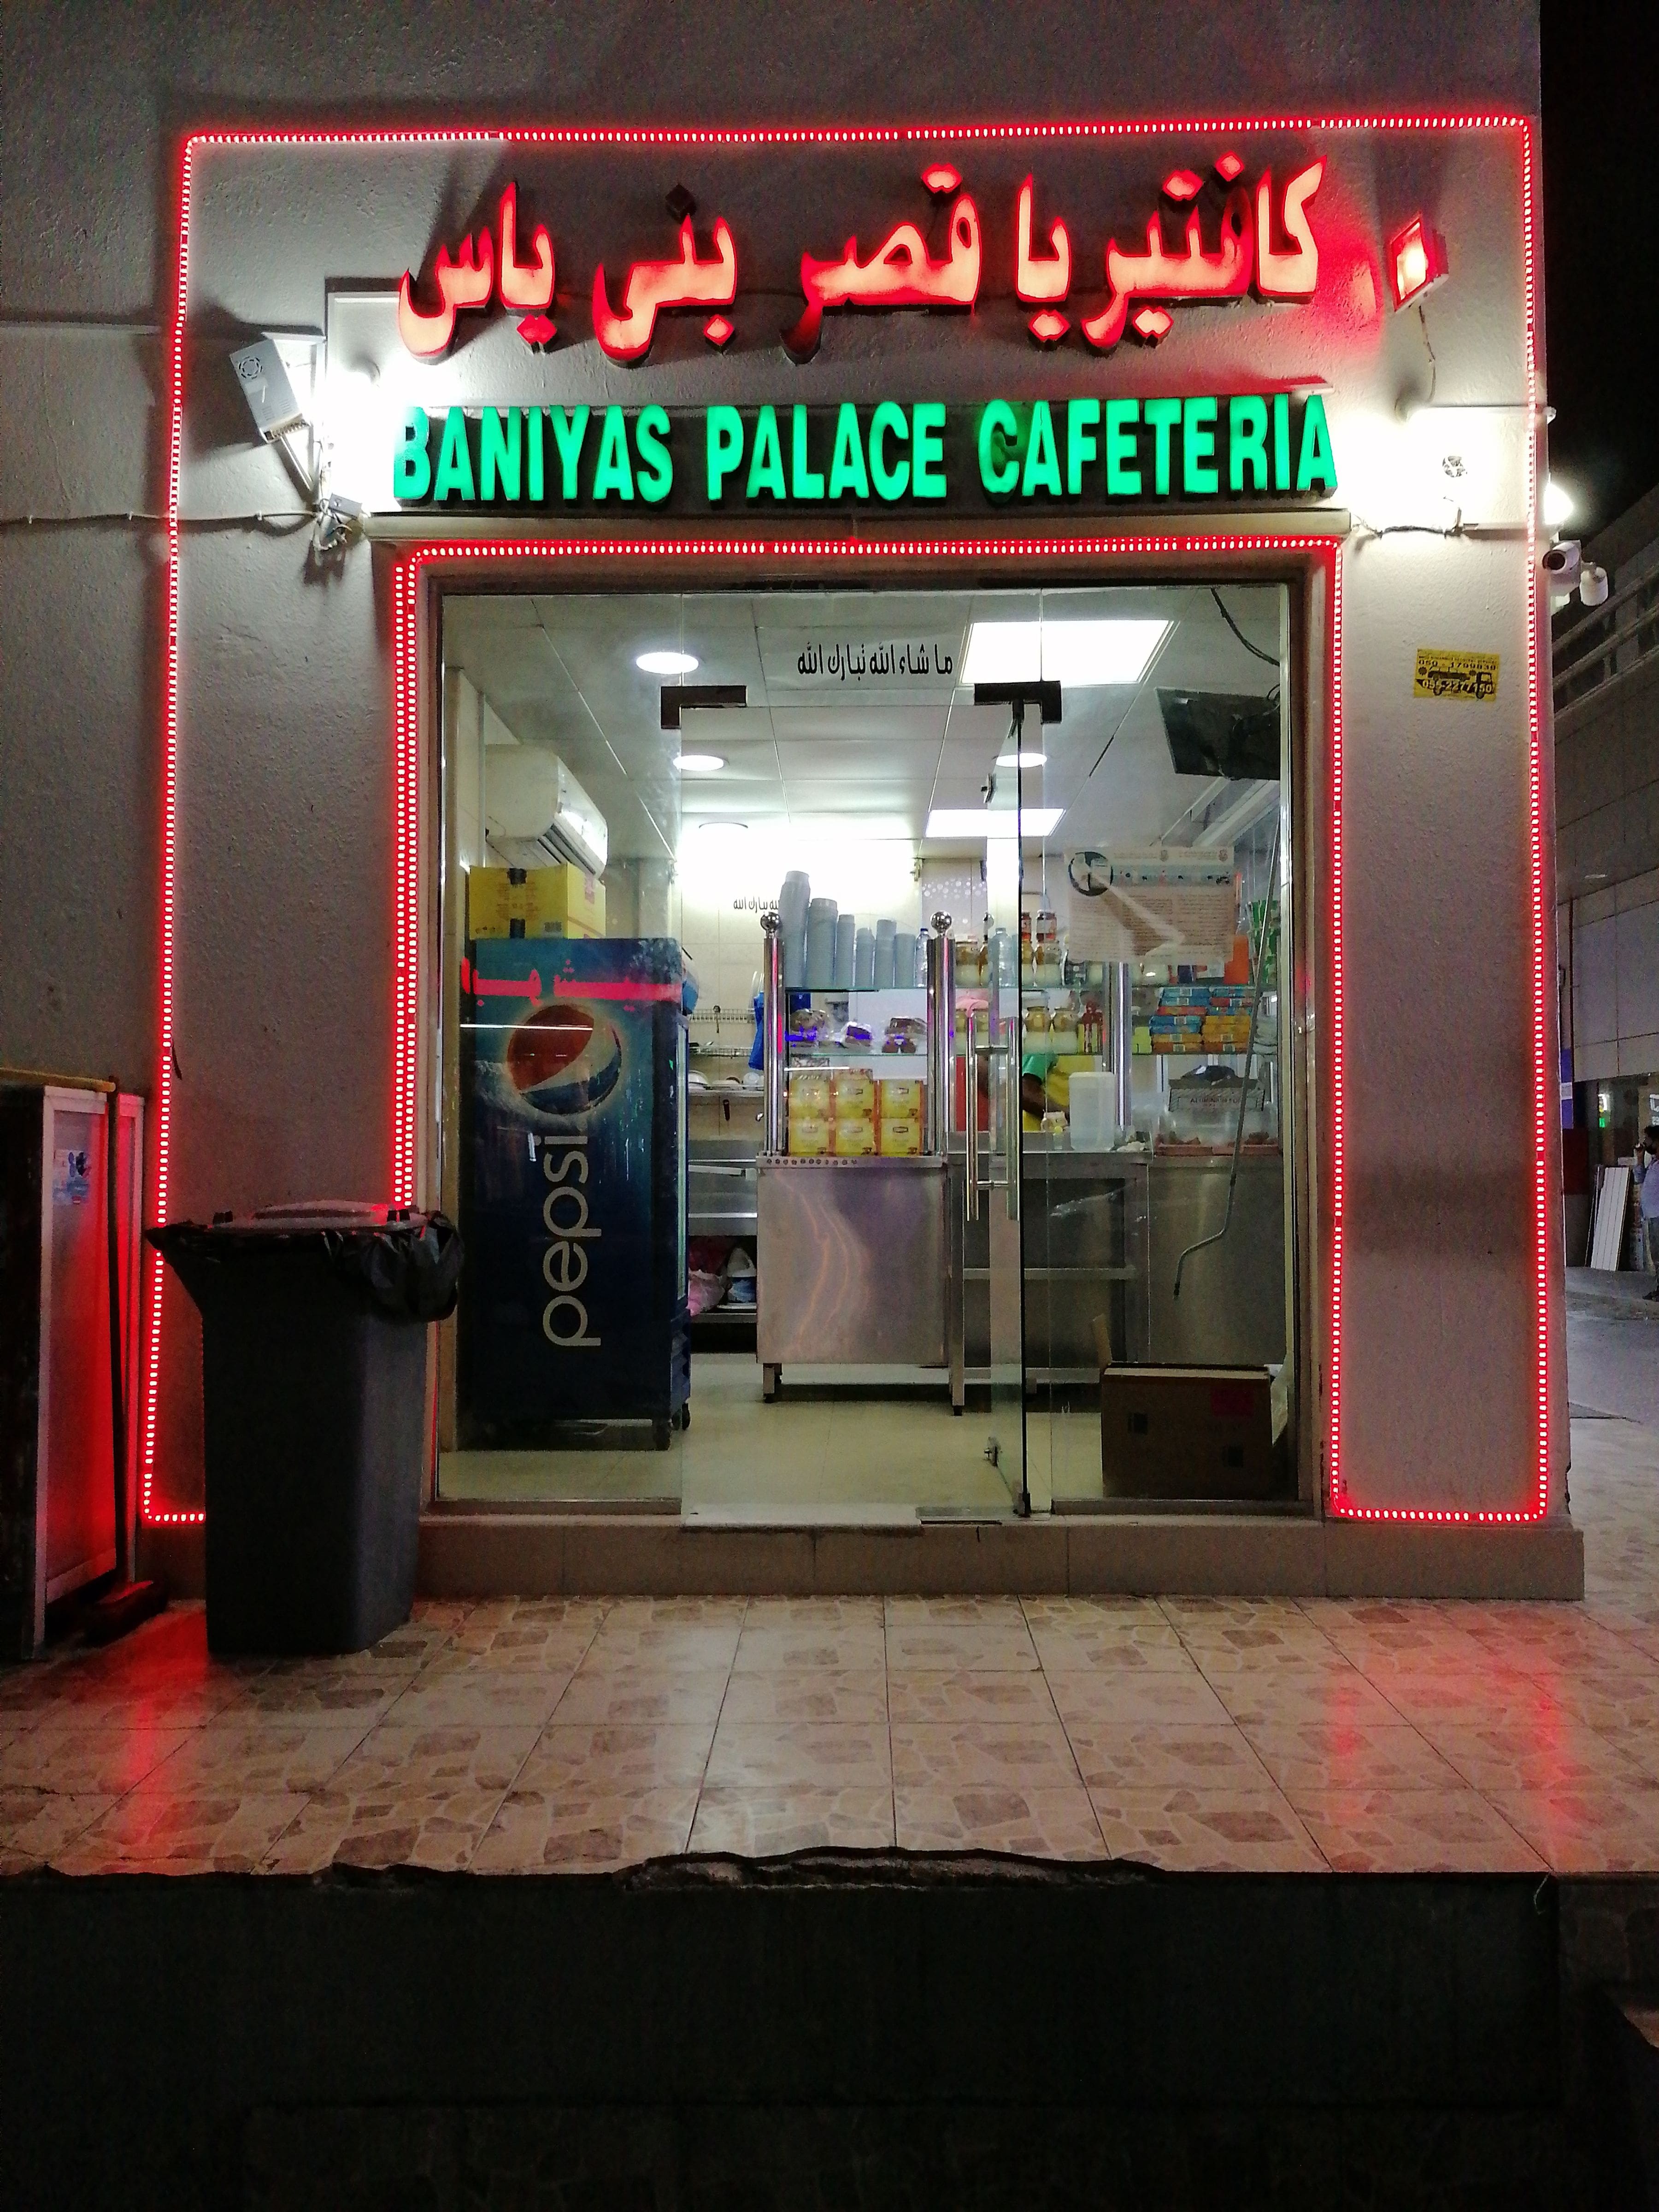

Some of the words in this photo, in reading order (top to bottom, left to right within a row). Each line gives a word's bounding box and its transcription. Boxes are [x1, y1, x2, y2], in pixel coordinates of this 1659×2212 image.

[398, 181, 557, 359] ياس
[780, 168, 982, 363] قصر
[1014, 151, 1328, 350] كافتيريا
[394, 404, 674, 502] BANIYAS
[706, 400, 947, 501] PALACE
[977, 393, 1339, 497] CAFETERIA
[797, 641, 824, 675] الله
[828, 643, 867, 681] تبارك
[869, 642, 896, 675] الله
[534, 1135, 601, 1347] pepsi
